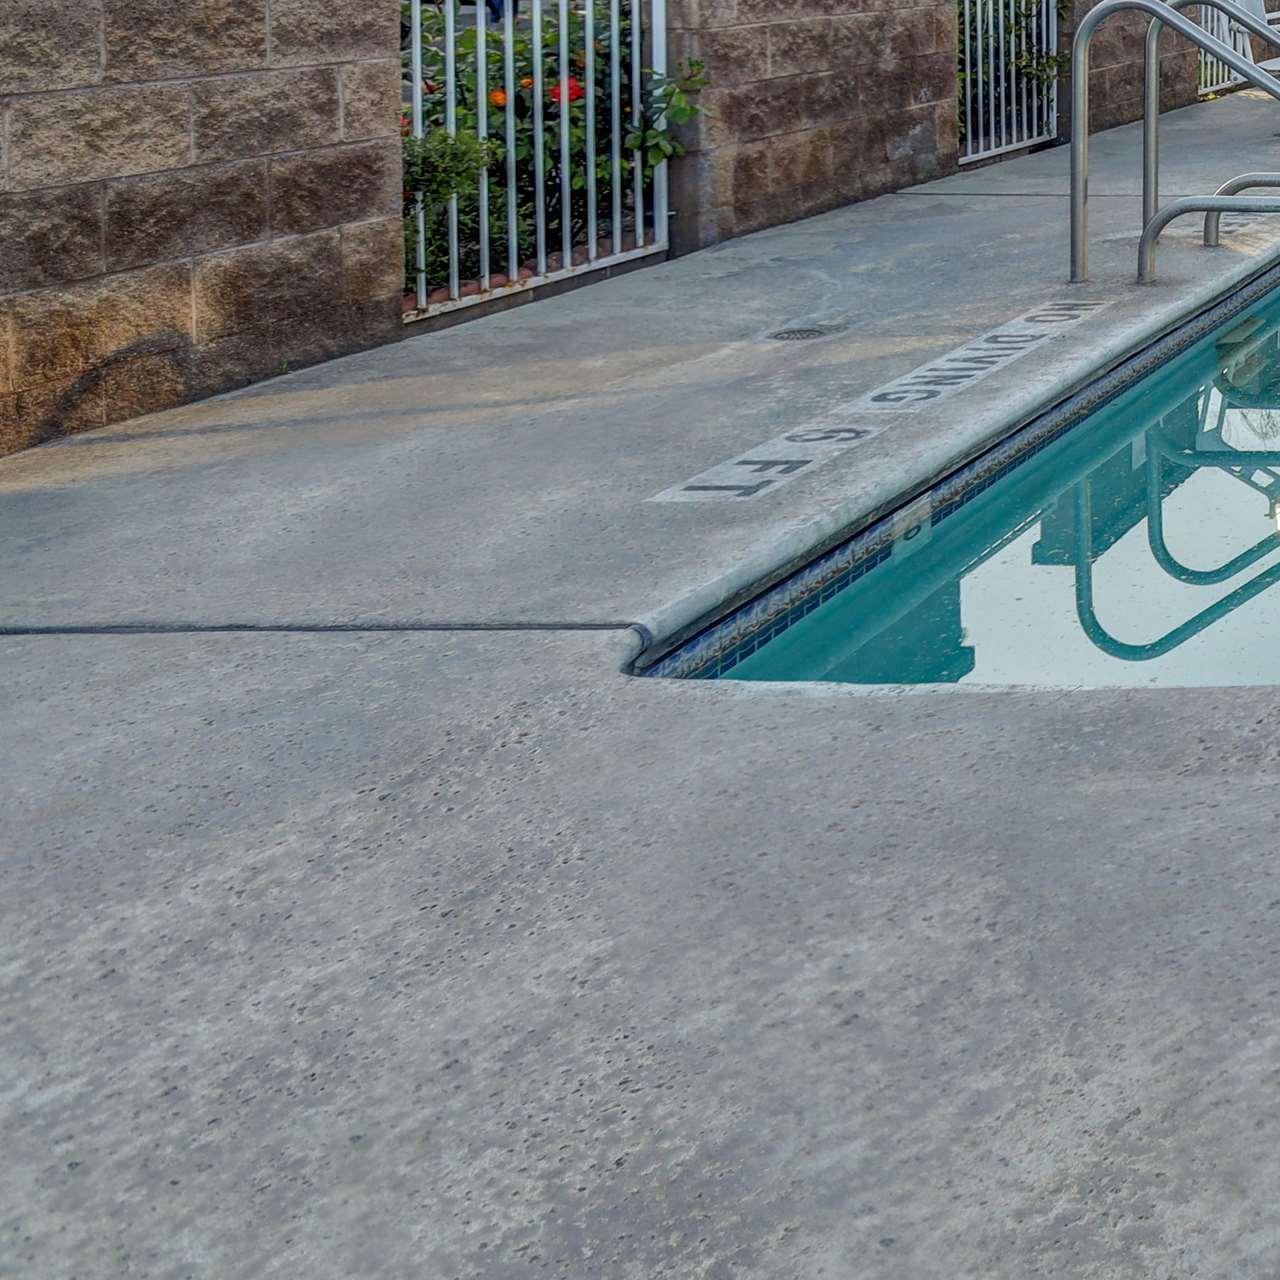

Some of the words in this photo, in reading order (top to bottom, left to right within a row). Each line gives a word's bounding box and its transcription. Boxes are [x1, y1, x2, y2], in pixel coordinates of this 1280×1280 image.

[1024, 302, 1104, 323] NO
[870, 333, 1050, 403] DIVING
[682, 458, 814, 498] FT
